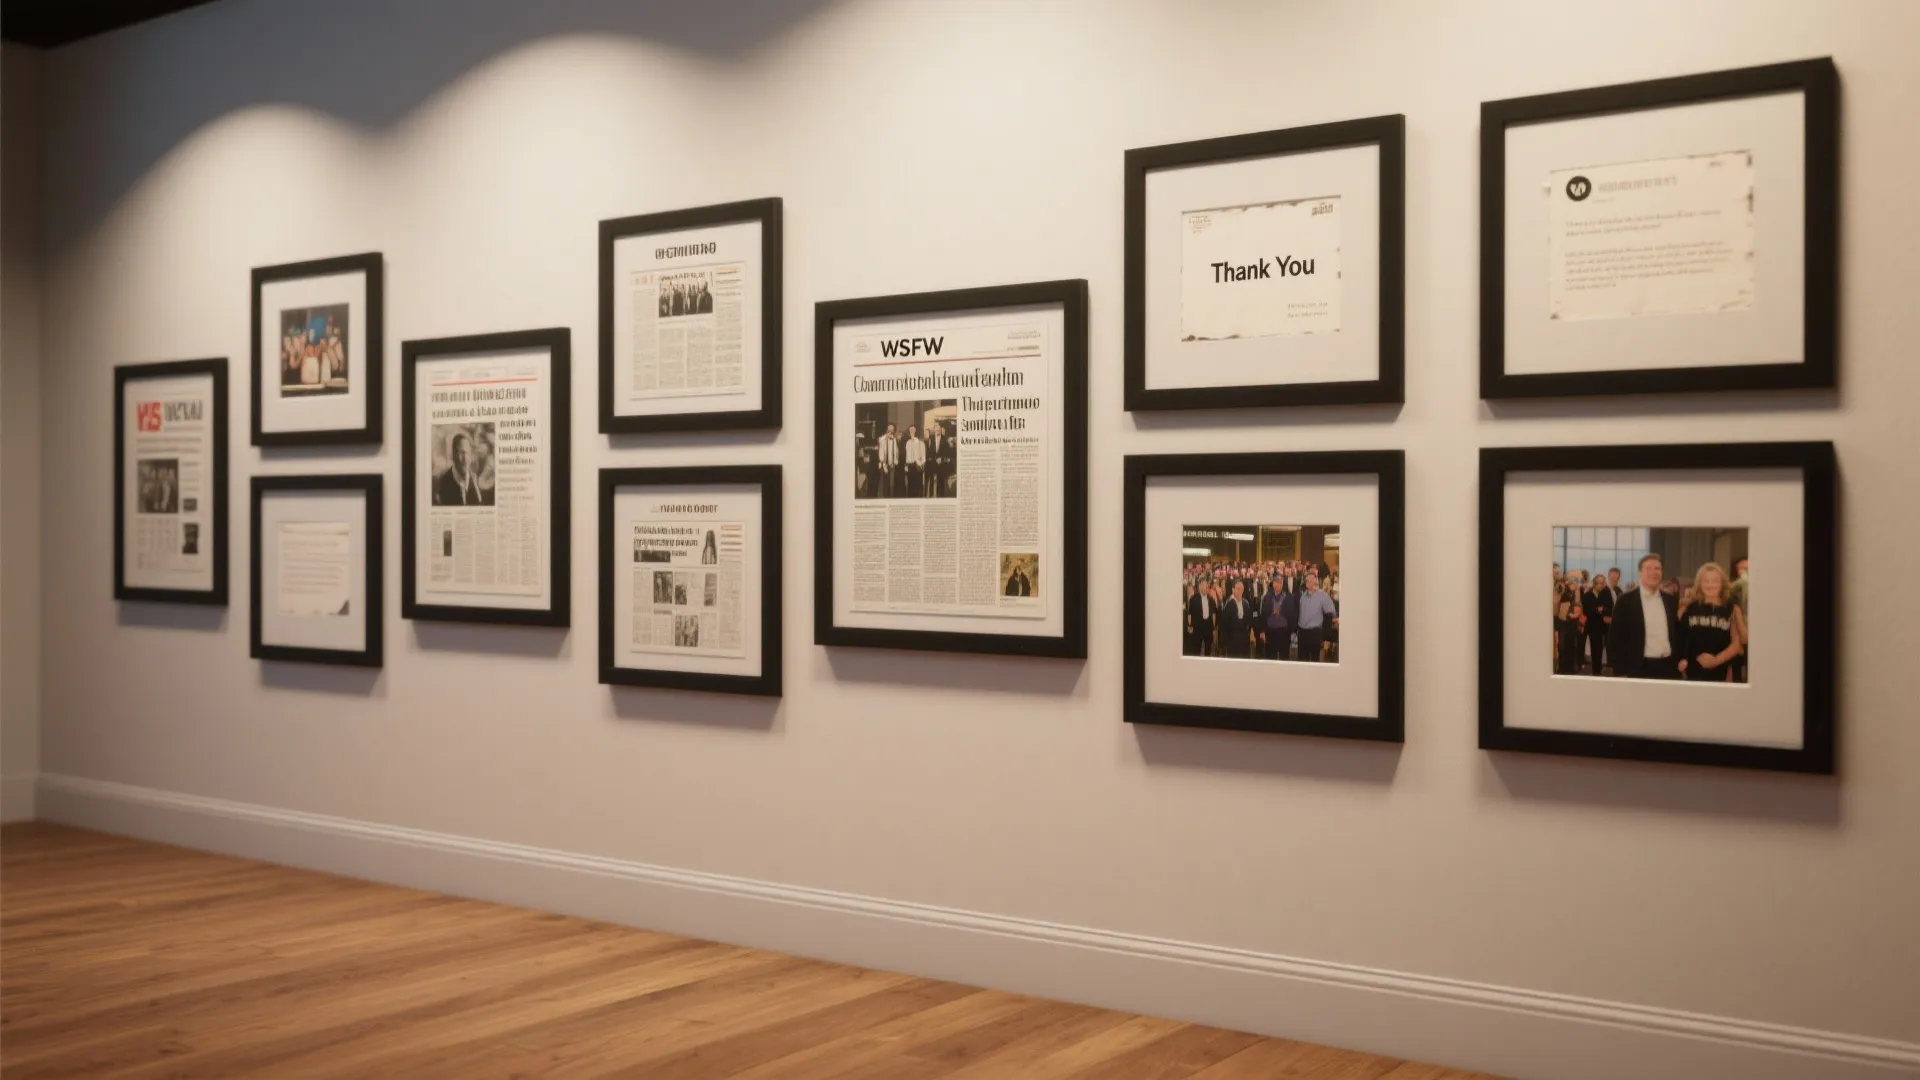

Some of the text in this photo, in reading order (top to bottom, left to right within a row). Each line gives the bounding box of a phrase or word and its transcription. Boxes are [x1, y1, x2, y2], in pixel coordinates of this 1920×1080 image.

[1211, 255, 1315, 283] Thank You
[881, 336, 944, 358] WSFW
